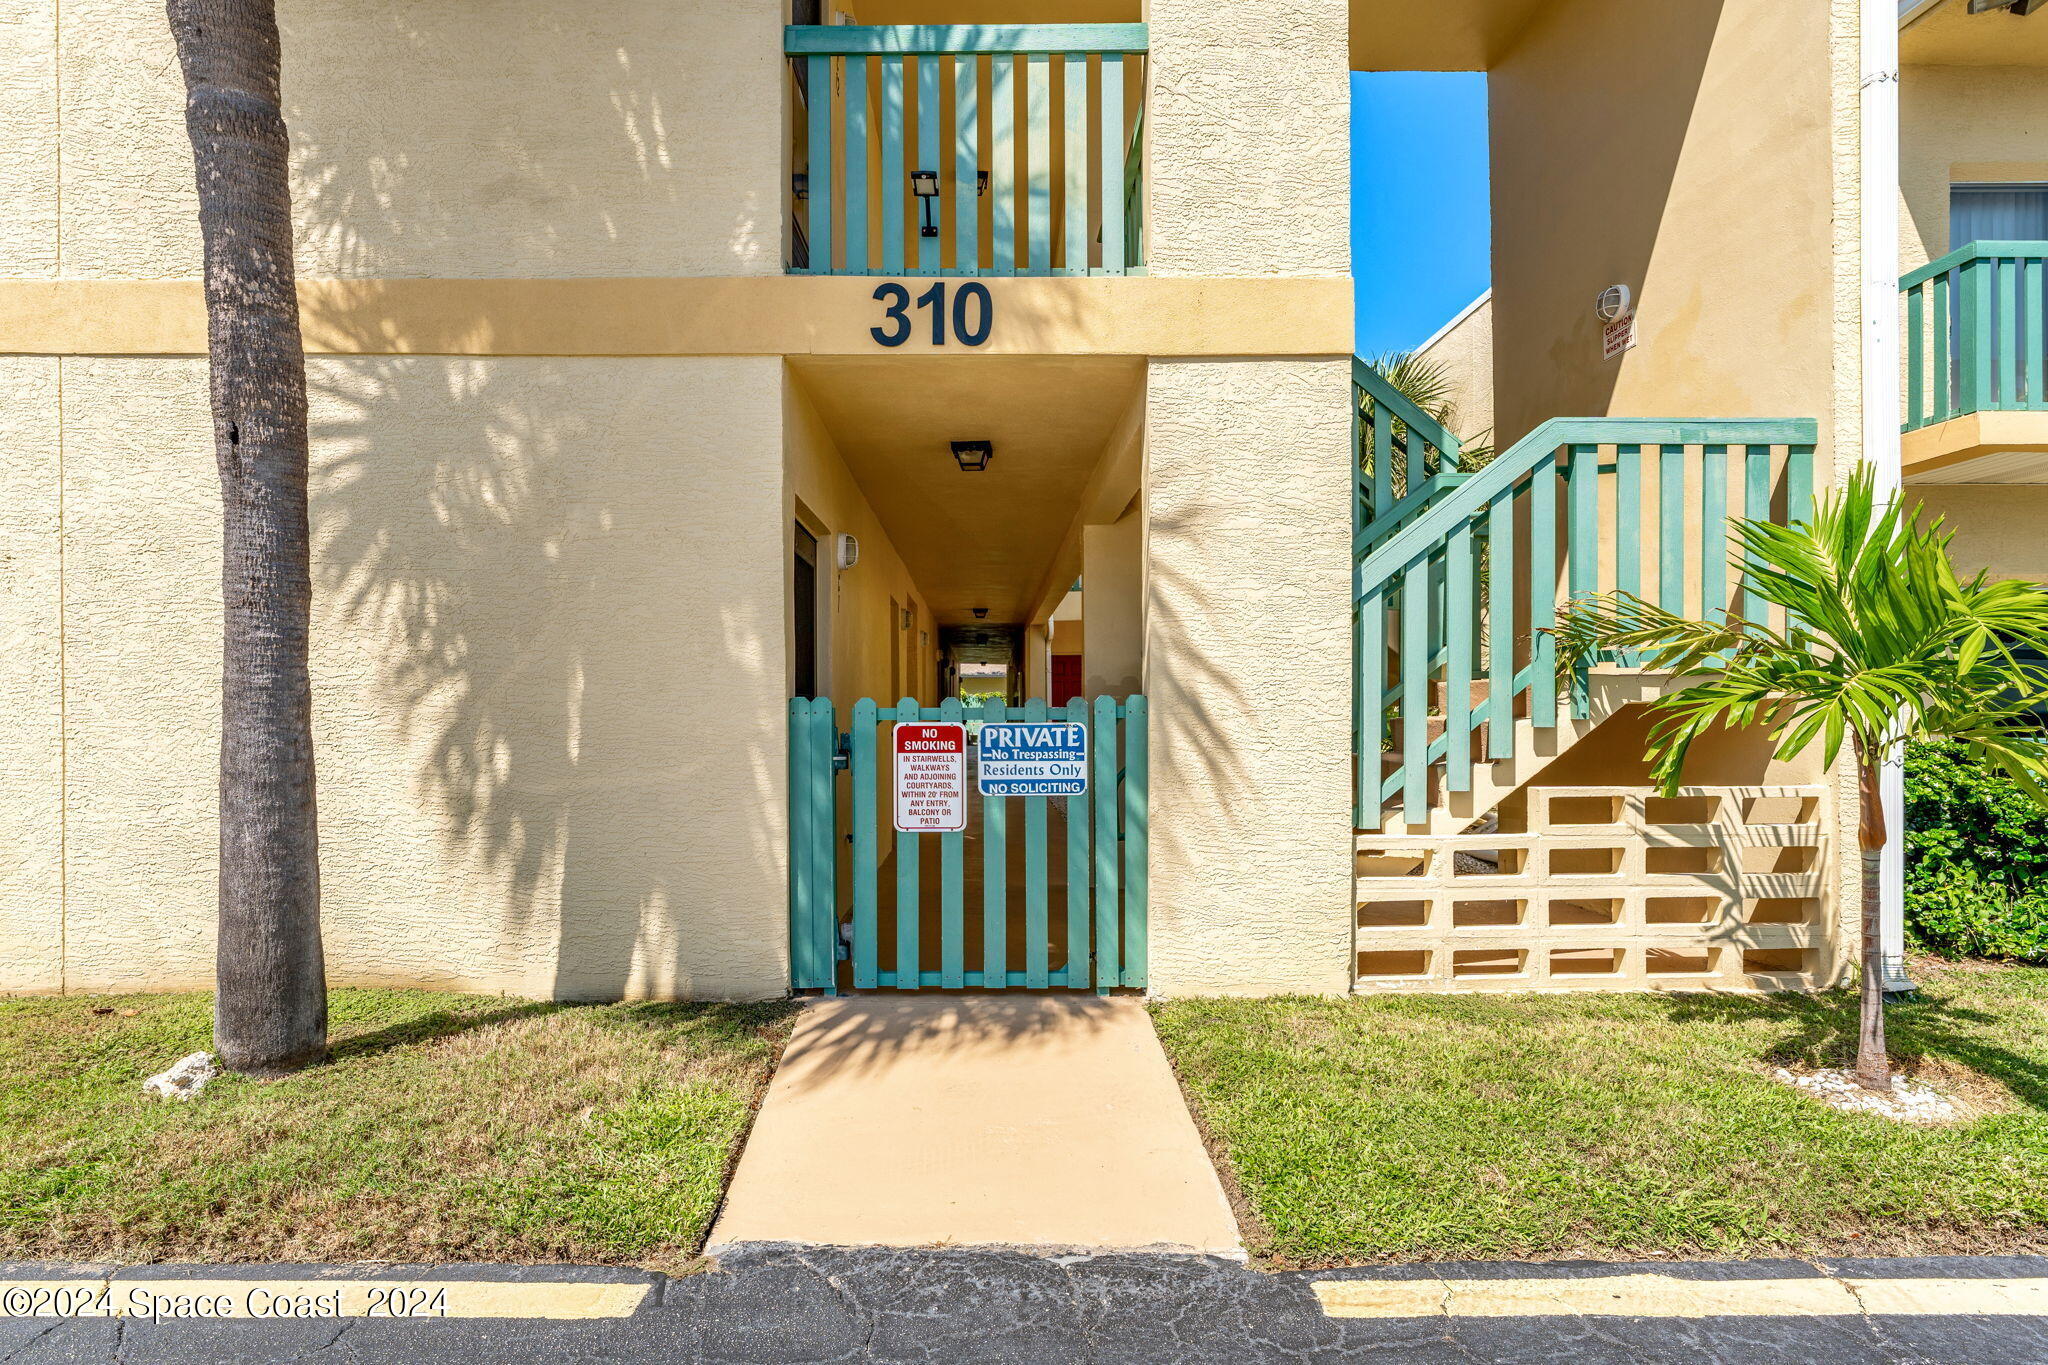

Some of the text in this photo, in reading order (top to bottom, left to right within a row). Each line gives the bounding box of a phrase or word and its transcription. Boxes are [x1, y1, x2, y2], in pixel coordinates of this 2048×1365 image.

[870, 282, 993, 347] 310
[1606, 315, 1632, 335] CAUTION
[1606, 335, 1632, 354] WHEN WET
[922, 729, 938, 739] NO
[985, 727, 1080, 747] PRIVATE
[904, 741, 956, 751] SMOKING
[984, 764, 1081, 777] Residents Only
[989, 782, 1081, 794] NO SOLICITING
